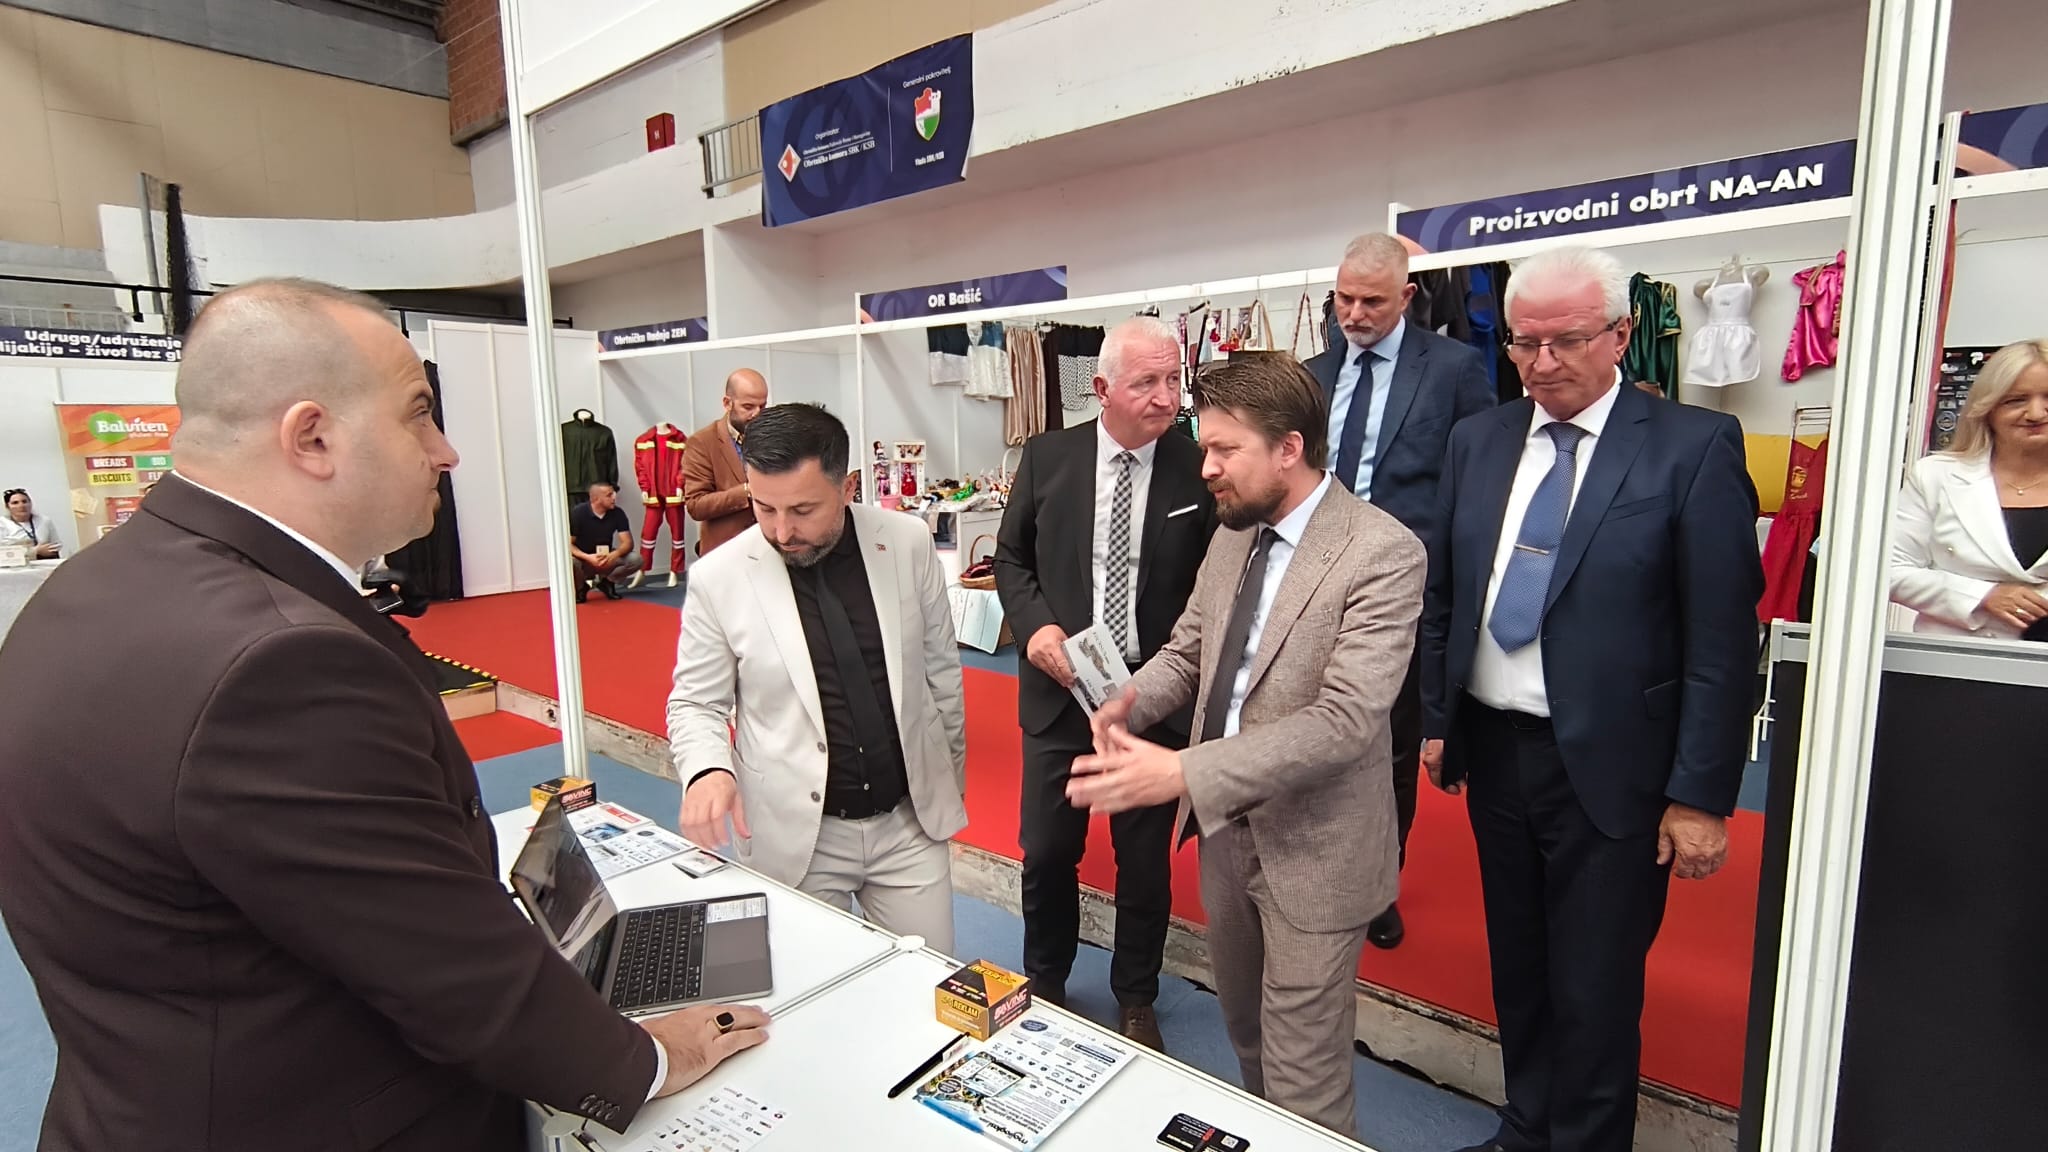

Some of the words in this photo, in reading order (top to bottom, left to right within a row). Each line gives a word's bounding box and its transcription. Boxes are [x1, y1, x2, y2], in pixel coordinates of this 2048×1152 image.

[1469, 192, 1620, 237] Proizvodni
[1629, 182, 1699, 213] obrt
[1709, 162, 1825, 202] NA-AN
[928, 294, 946, 308] OR
[949, 287, 982, 306] Bašić
[24, 330, 182, 350] Udruga/udruženje
[85, 344, 128, 358] život
[132, 348, 162, 359] bez
[93, 472, 132, 483] BISCUITS
[953, 1000, 979, 1018] REKLAM
